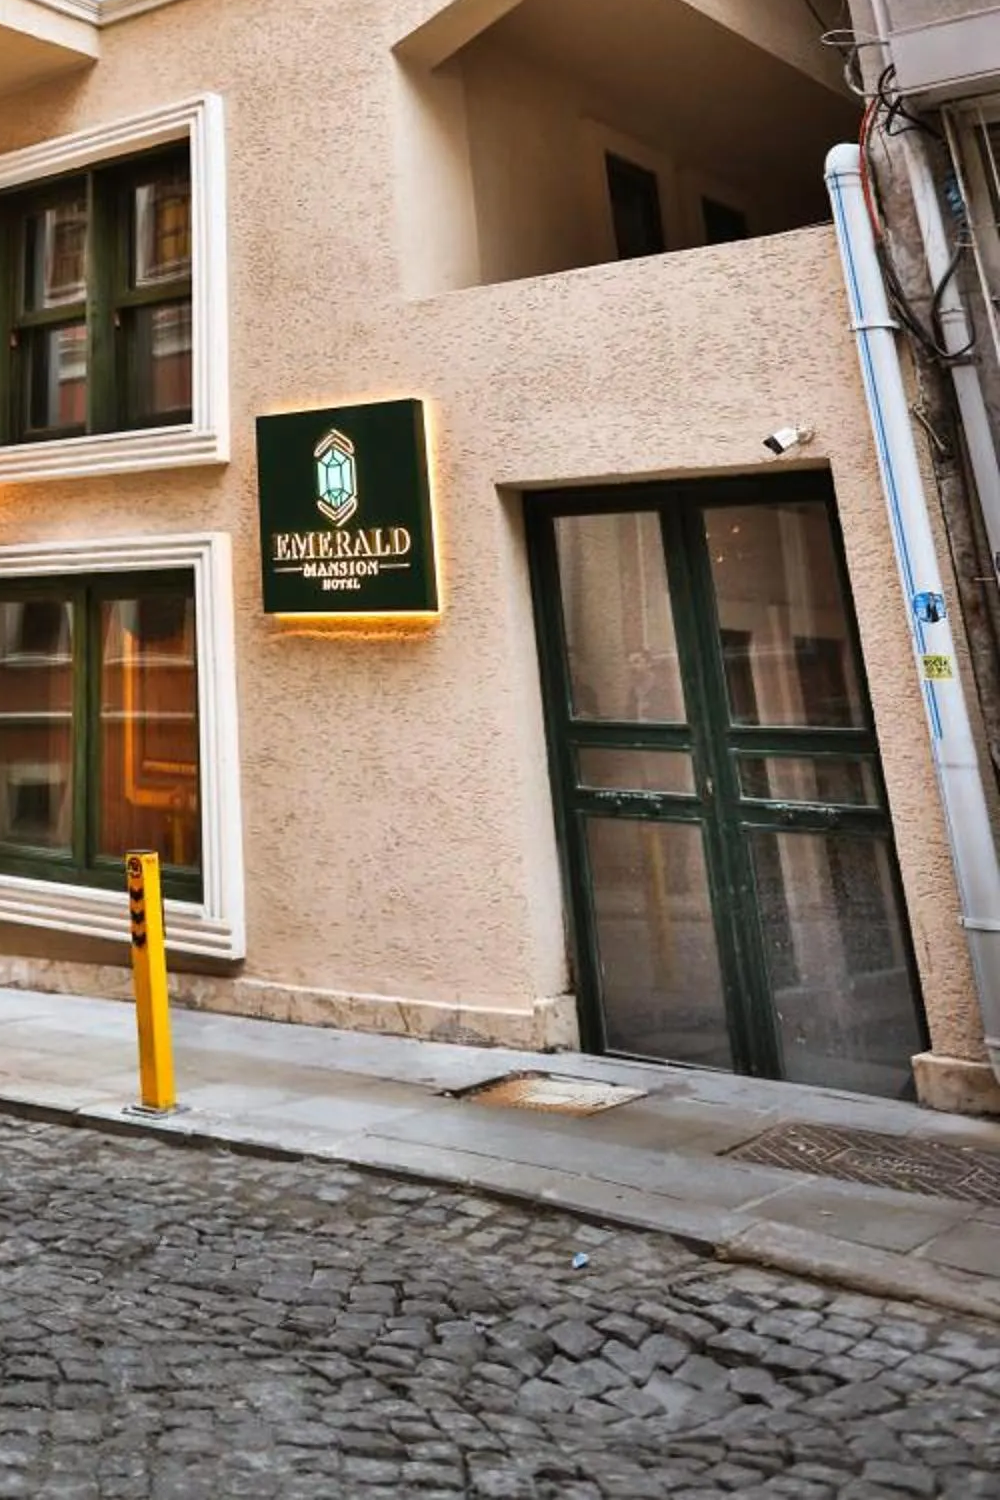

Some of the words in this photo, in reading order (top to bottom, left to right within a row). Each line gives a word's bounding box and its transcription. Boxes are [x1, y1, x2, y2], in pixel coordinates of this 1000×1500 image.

[273, 527, 411, 560] EMERALD
[303, 560, 379, 577] MANSION
[322, 578, 361, 591] HOTEL
